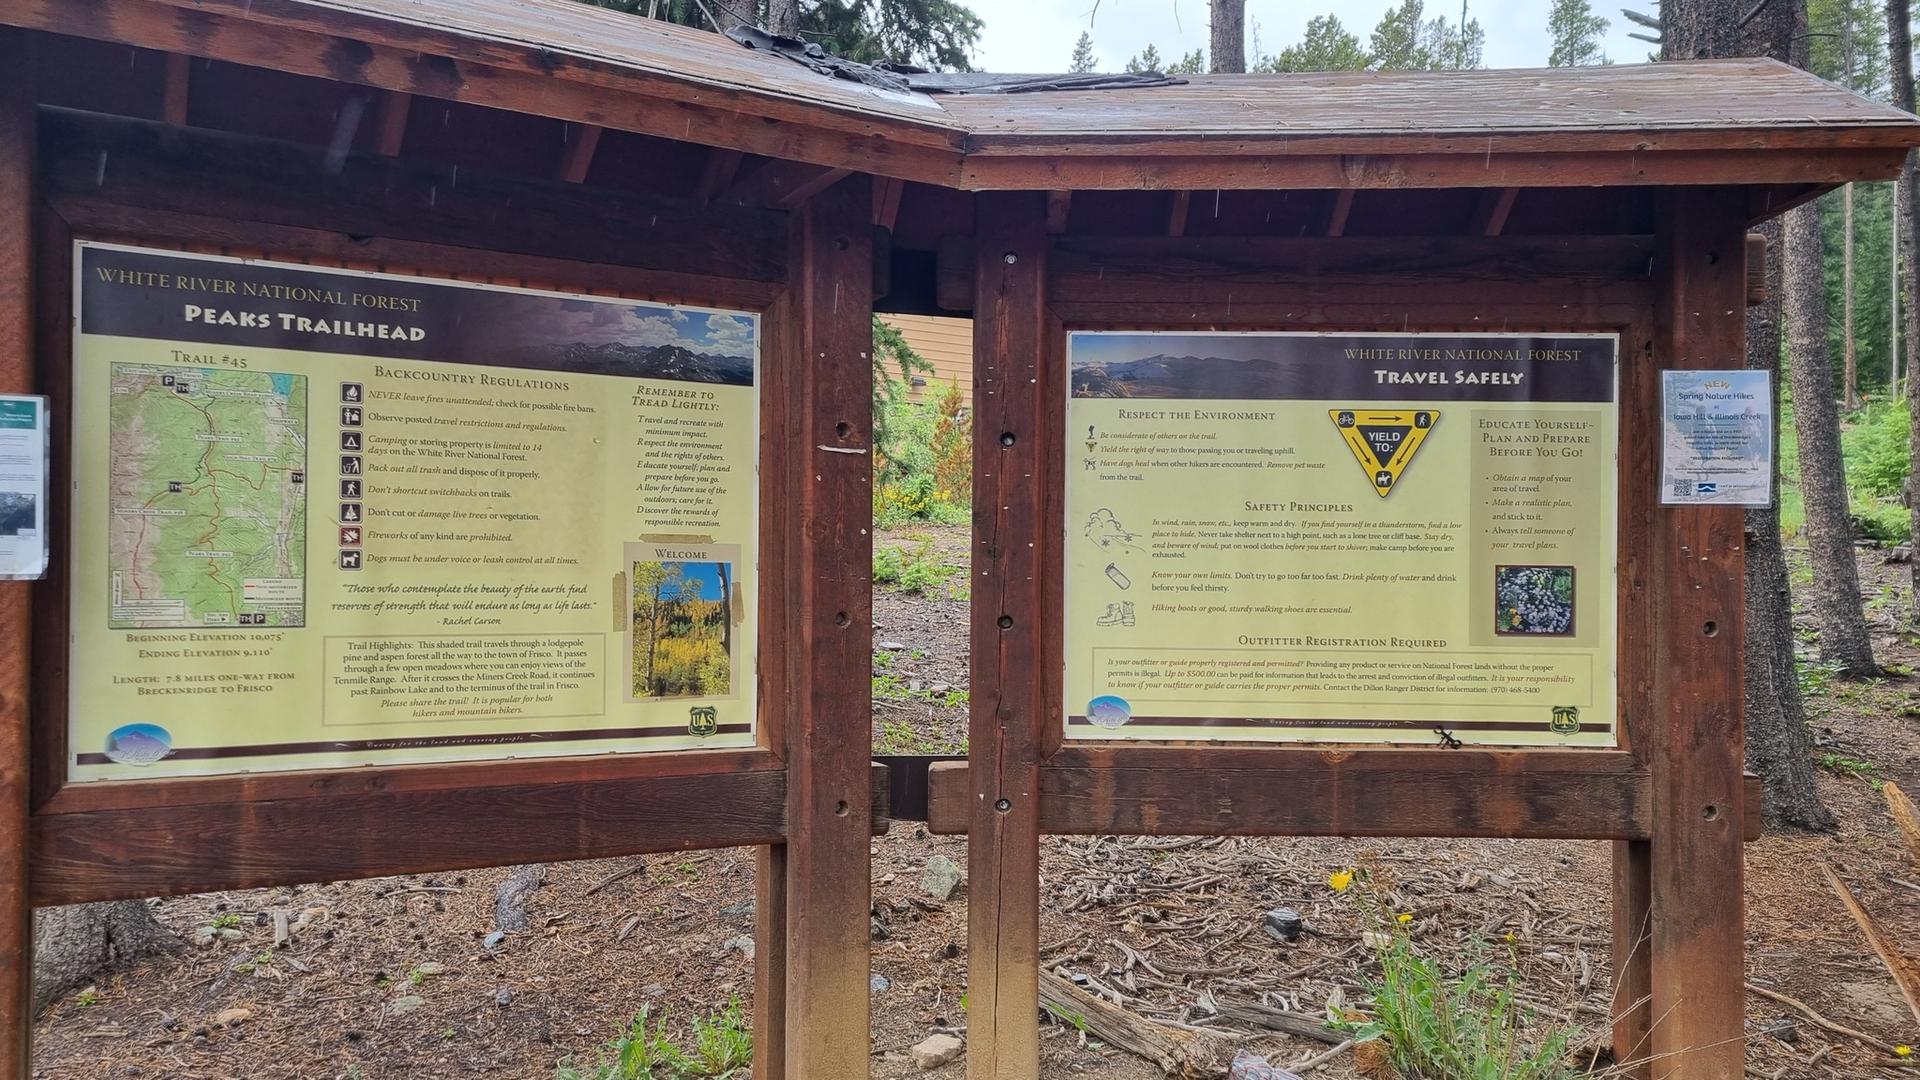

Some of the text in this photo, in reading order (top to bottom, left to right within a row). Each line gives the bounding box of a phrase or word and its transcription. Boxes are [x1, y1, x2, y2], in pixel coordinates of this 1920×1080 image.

[96, 267, 421, 312] WHITE RIVER NATIONAL FOREST
[185, 304, 426, 341] PEAKS TRAILHEAD
[170, 350, 248, 369] TRAIL #45
[1344, 348, 1581, 361] WHITE RIVER NATIONAL FOREST
[375, 365, 569, 391] BACKCOUNTRY REGULATIONS
[1374, 370, 1524, 385] TRAVEL SAFELY
[636, 385, 715, 400] REMEMBER TO
[368, 390, 402, 400] NEVER
[403, 392, 426, 404] leave
[425, 394, 444, 404] fires
[495, 399, 519, 409] check
[520, 400, 532, 409] for
[532, 401, 563, 412] possible
[563, 403, 576, 415] fire
[632, 396, 720, 411] TREAD LIGHTLY:
[368, 412, 404, 423] Observe
[405, 416, 433, 425] posted
[434, 417, 458, 426] travel
[459, 419, 504, 428] restrictions
[505, 421, 522, 429] and
[1118, 409, 1276, 421] RESPECT THE ENVIRONMENT
[1479, 419, 1531, 429] EDUCATE
[645, 428, 681, 436] minimum
[1110, 432, 1149, 440] considerate
[1149, 432, 1158, 441] of
[1156, 432, 1178, 440] others
[1189, 432, 1200, 440] the
[1368, 432, 1401, 442] YIELD
[1483, 432, 1591, 444] PLAN AND PREPARE
[1374, 443, 1393, 452] TO:
[1489, 447, 1583, 458] BEFORE YOU GO!
[645, 450, 661, 458] and
[661, 450, 673, 459] the
[674, 451, 694, 461] rights
[694, 452, 703, 462] of
[368, 463, 389, 472] Pack
[406, 465, 419, 473] all
[419, 466, 441, 474] trash
[442, 466, 458, 475] and
[459, 467, 489, 478] dispose
[490, 468, 500, 477] of
[498, 468, 506, 478] it
[644, 474, 673, 482] prepare
[674, 473, 696, 484] before
[696, 476, 709, 484] you
[1099, 473, 1116, 481] from
[1117, 473, 1128, 481] the
[392, 486, 428, 495] shortcut
[429, 488, 478, 497] switchbacks
[1245, 501, 1353, 512] SAFETY PRINCIPLES
[1491, 498, 1514, 507] Make
[1521, 498, 1552, 507] realistic
[1492, 512, 1507, 520] and
[1507, 512, 1526, 521] stick
[644, 518, 684, 527] responsible
[368, 531, 409, 540] Fireworks
[409, 531, 420, 540] of
[419, 532, 435, 542] any
[435, 532, 454, 543] kind
[1491, 526, 1519, 537] Always
[1520, 527, 1533, 535] tell
[1566, 527, 1577, 537] of
[654, 548, 707, 559] WELCOME
[1151, 603, 1177, 613] Hiking
[1177, 603, 1197, 612] boots
[1198, 606, 1207, 615] or
[1229, 605, 1253, 615] sturdy
[1254, 605, 1283, 615] walking
[1284, 605, 1304, 613] shoes
[442, 616, 473, 626] Rachel
[474, 617, 502, 625] Carson
[126, 634, 187, 643] BEGINNING
[189, 633, 247, 642] ELEVATION
[1238, 635, 1447, 649] OUTFITTER REGISTRATION REQUIRED
[347, 641, 368, 650] Trail
[369, 641, 416, 652] Highlights:
[417, 641, 436, 649] This
[435, 640, 465, 649] shaded
[466, 640, 483, 648] trail
[484, 640, 510, 648] travels
[510, 639, 541, 651] through
[548, 639, 585, 650] lodgepole
[138, 649, 181, 659] ENDING
[183, 649, 241, 658] ELEVATION
[166, 674, 182, 683] 7.8
[217, 674, 265, 682] ONE-WAY
[137, 687, 218, 696] BRECKENRIDGE
[237, 684, 273, 693] FRISCO
